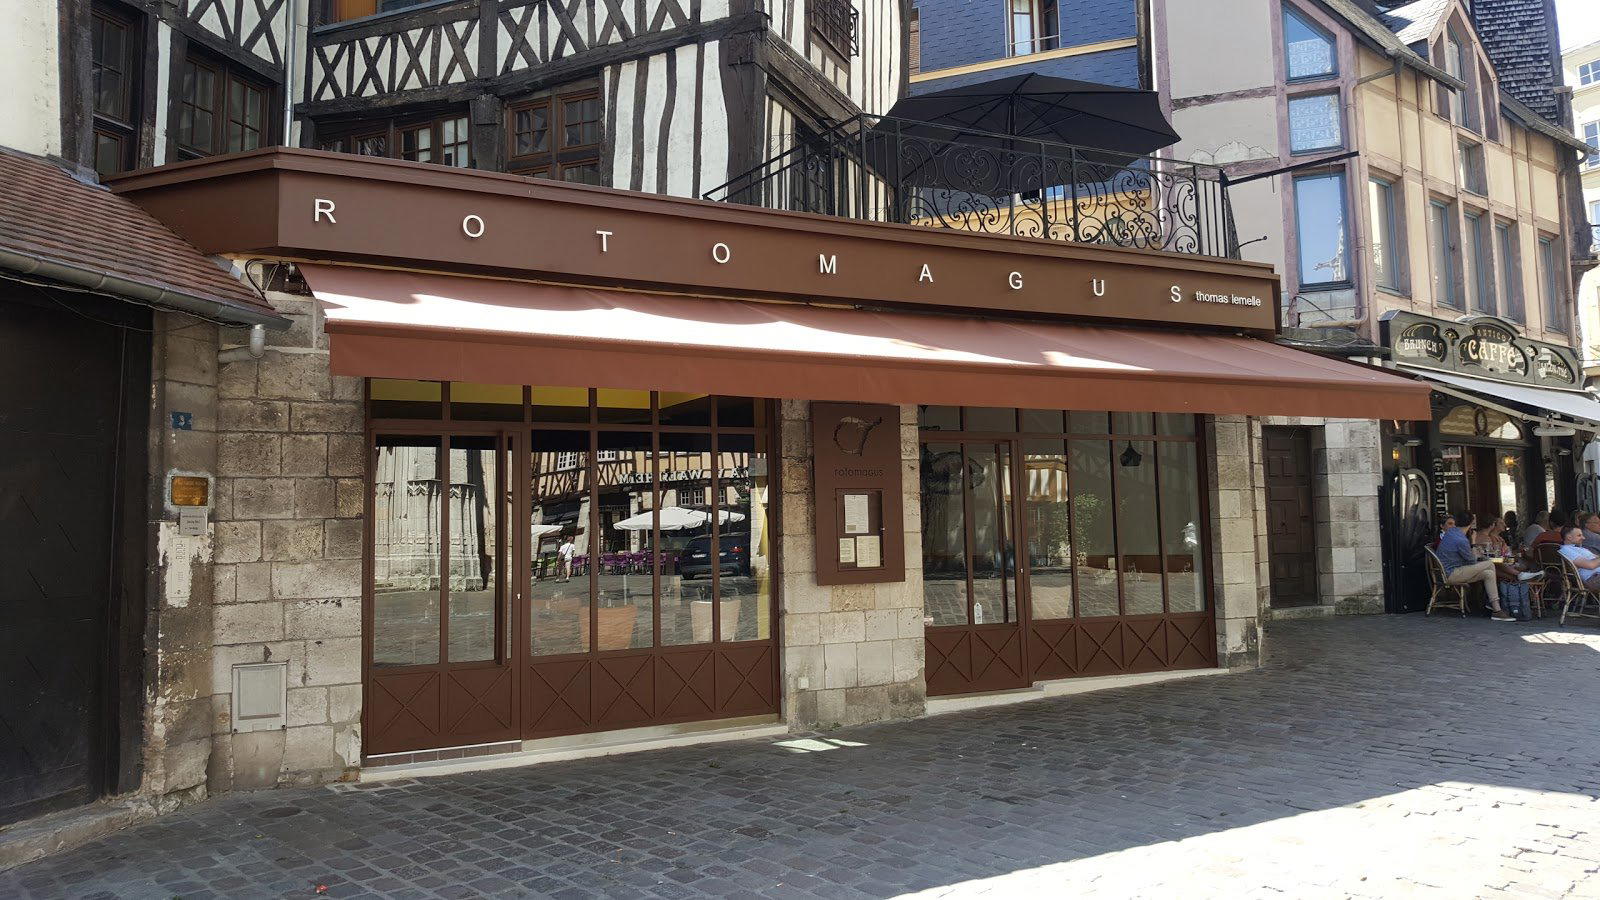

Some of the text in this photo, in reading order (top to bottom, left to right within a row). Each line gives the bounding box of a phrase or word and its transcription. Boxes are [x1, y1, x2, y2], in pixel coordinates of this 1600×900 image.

[314, 198, 1182, 303] ROTOMAGUS
[1195, 290, 1261, 307] thomas lemelle
[1403, 338, 1438, 353] BRUNCH
[834, 466, 884, 478] rotomagus
